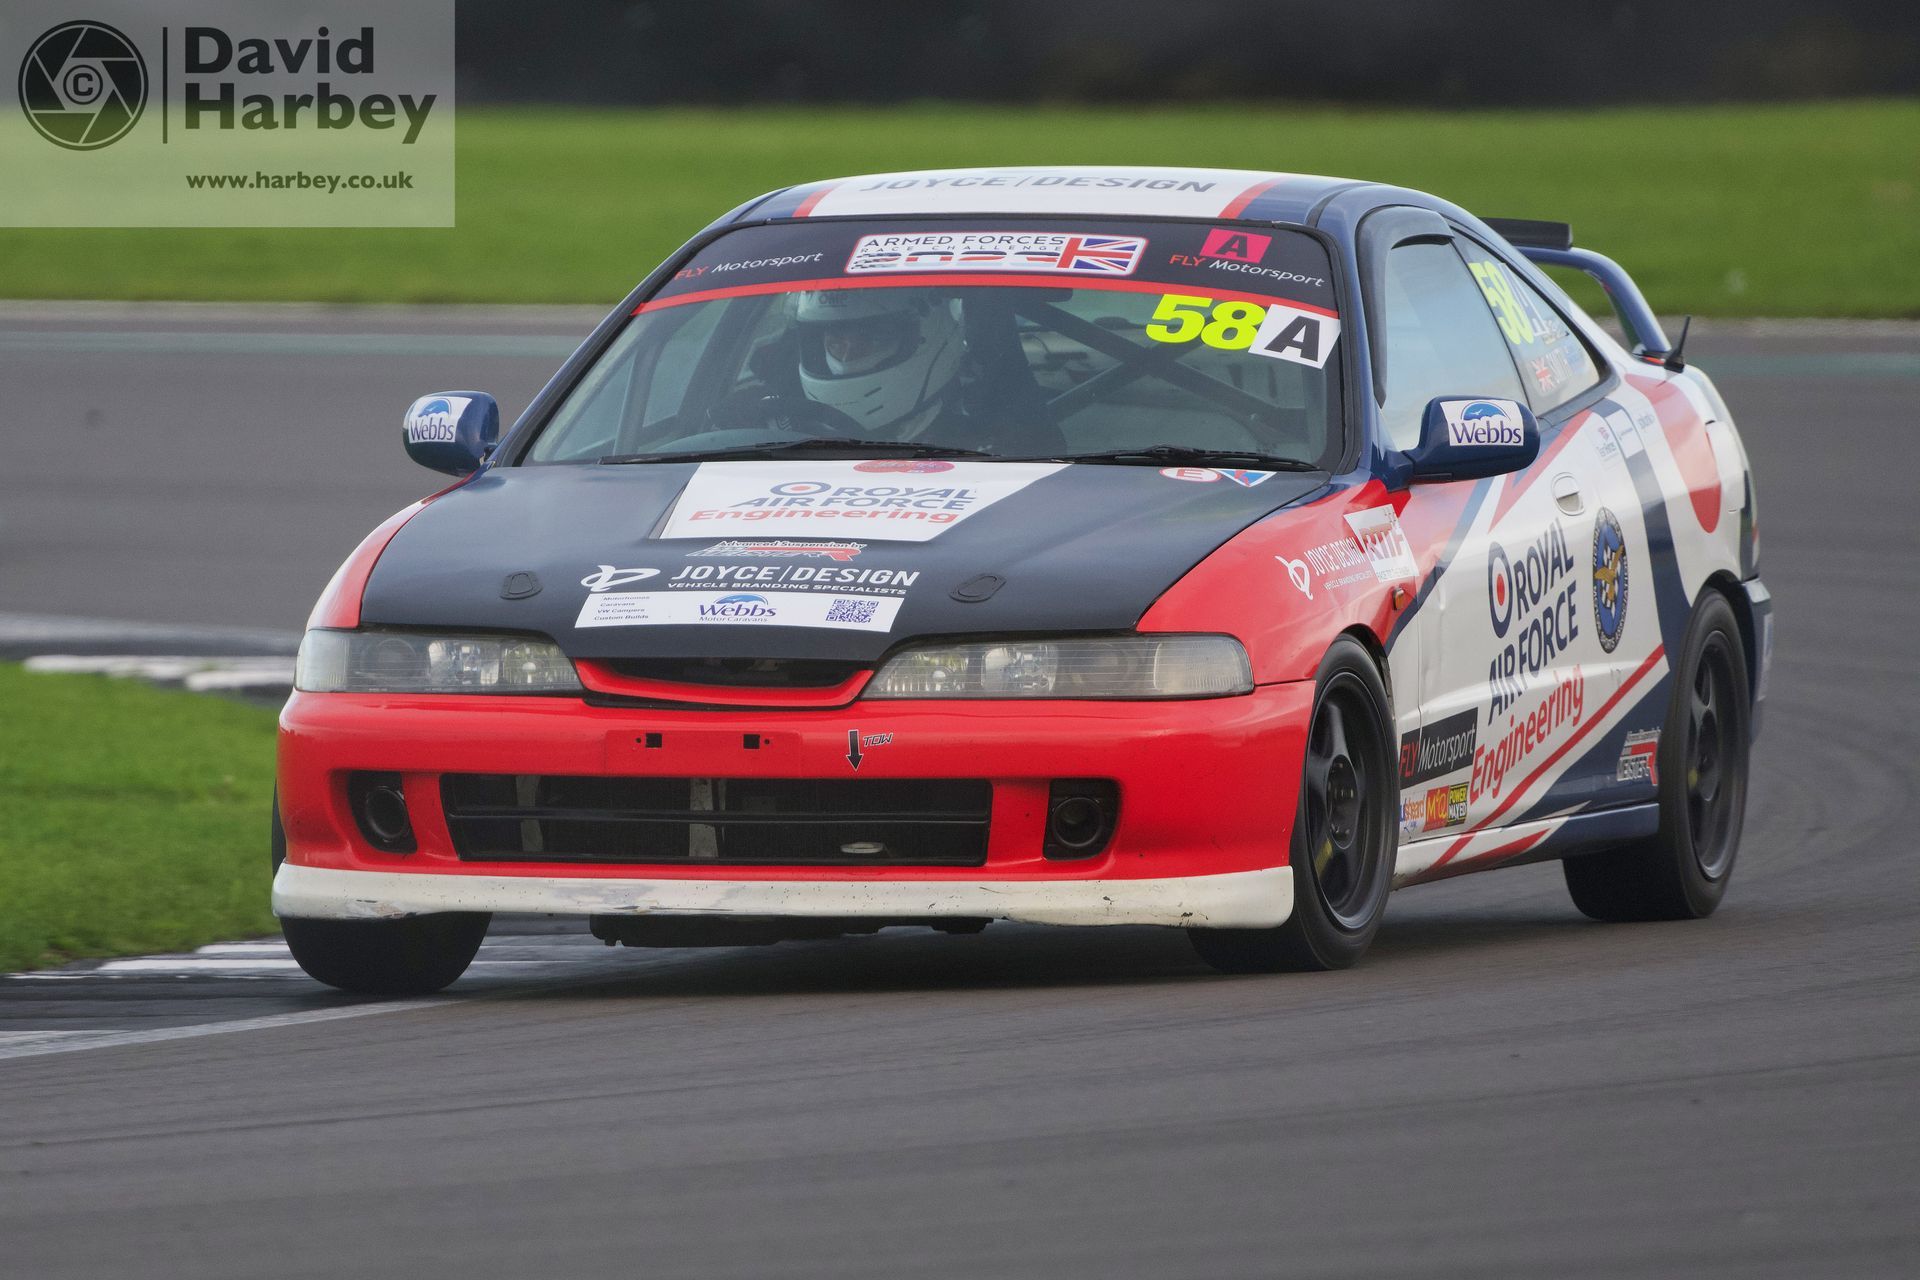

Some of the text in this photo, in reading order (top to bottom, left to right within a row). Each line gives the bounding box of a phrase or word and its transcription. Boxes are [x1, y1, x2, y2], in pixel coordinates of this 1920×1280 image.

[860, 245, 914, 253] RACE
[864, 235, 1067, 248] ARMED FORCES
[1218, 235, 1249, 259] A
[674, 250, 824, 281] FLY Motorsport
[1168, 254, 1325, 287] FLY Motorsport
[1467, 260, 1535, 345] 58
[1145, 293, 1321, 363] 58 A
[409, 417, 455, 441] Webbs
[1450, 420, 1522, 444] Webbs
[730, 497, 974, 511] AIR FORCE
[831, 487, 977, 500] ROYAL
[688, 507, 960, 525] Engineering
[671, 564, 920, 588] JOYCE/DESIGN
[1513, 517, 1575, 621] ROYAL
[667, 581, 907, 595] VEHICLE BRANDING SPECIALISTS
[699, 603, 777, 617] Webbs
[1487, 579, 1579, 726] AIR FORCE
[863, 732, 894, 748] TOW
[1469, 663, 1585, 806] Engineering
[1399, 722, 1476, 779] FLY Motorsport
